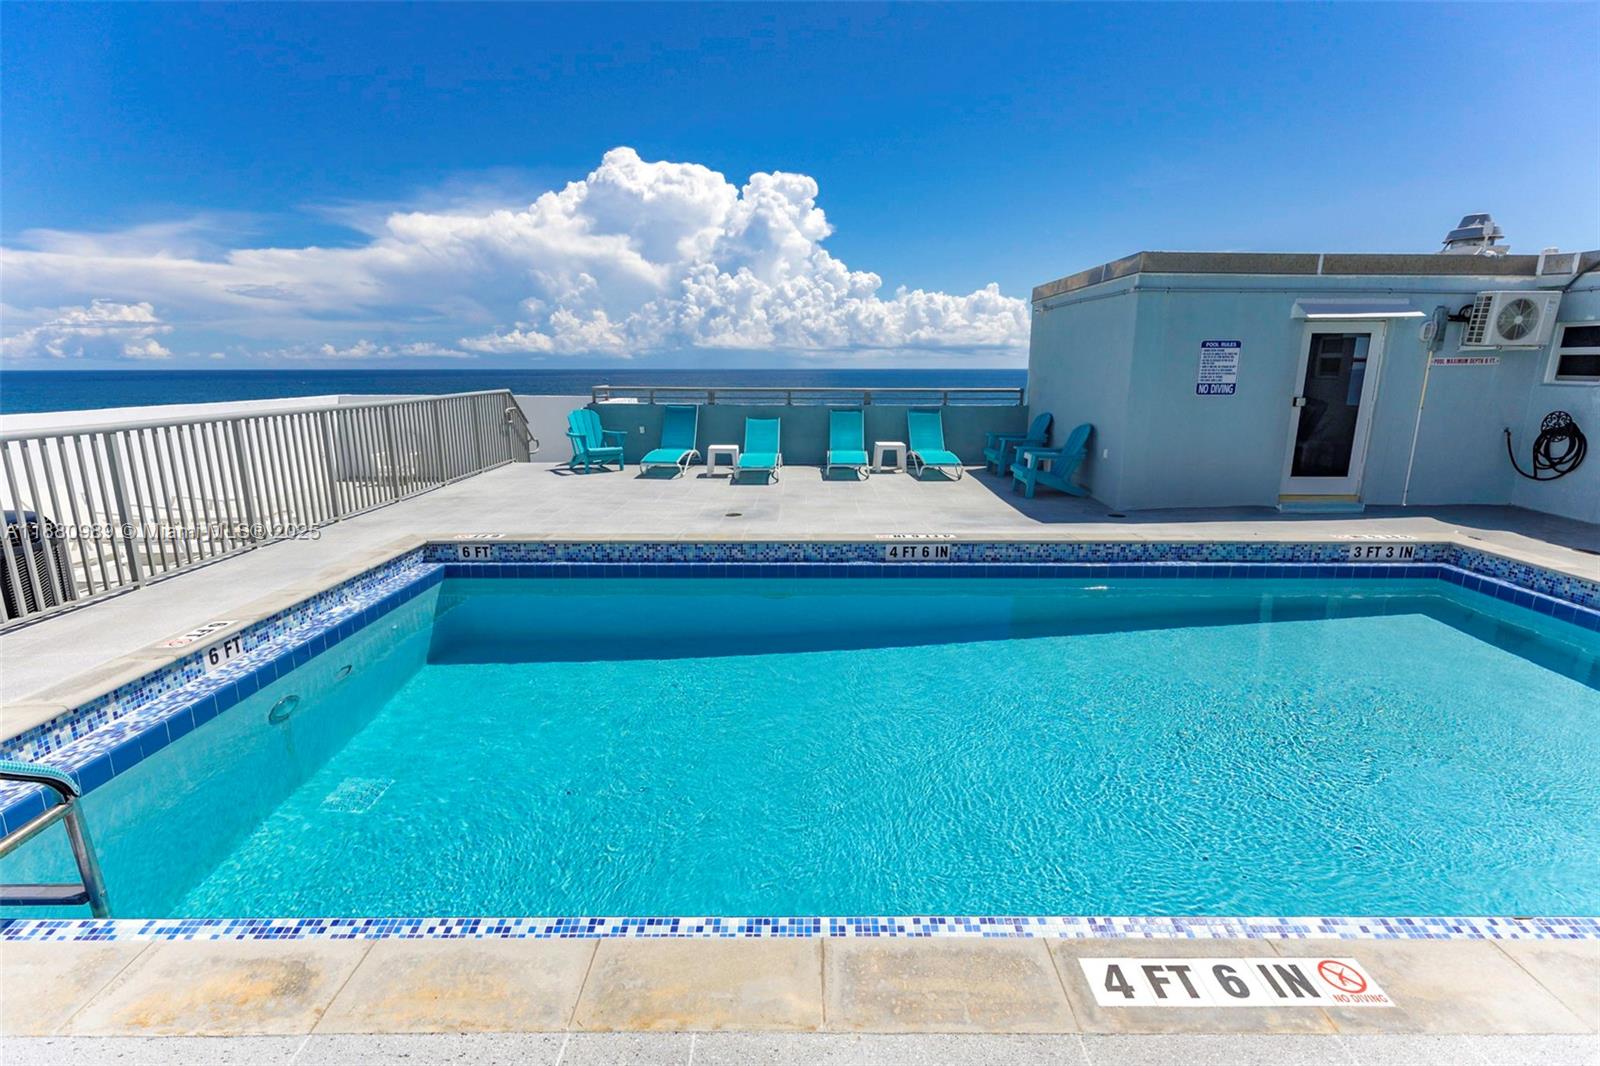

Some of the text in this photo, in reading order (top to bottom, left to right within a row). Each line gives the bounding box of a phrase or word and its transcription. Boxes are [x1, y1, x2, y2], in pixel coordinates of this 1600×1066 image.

[1198, 384, 1234, 393] NO DIVING
[462, 546, 489, 558] 6 FT
[889, 546, 948, 558] 4 FT 6 IN
[1353, 546, 1413, 558] 3 FT 3 IN
[208, 636, 241, 666] 6 FT
[1104, 964, 1321, 999] 4 FT 6 IN
[1332, 994, 1389, 1003] NO DIVING
